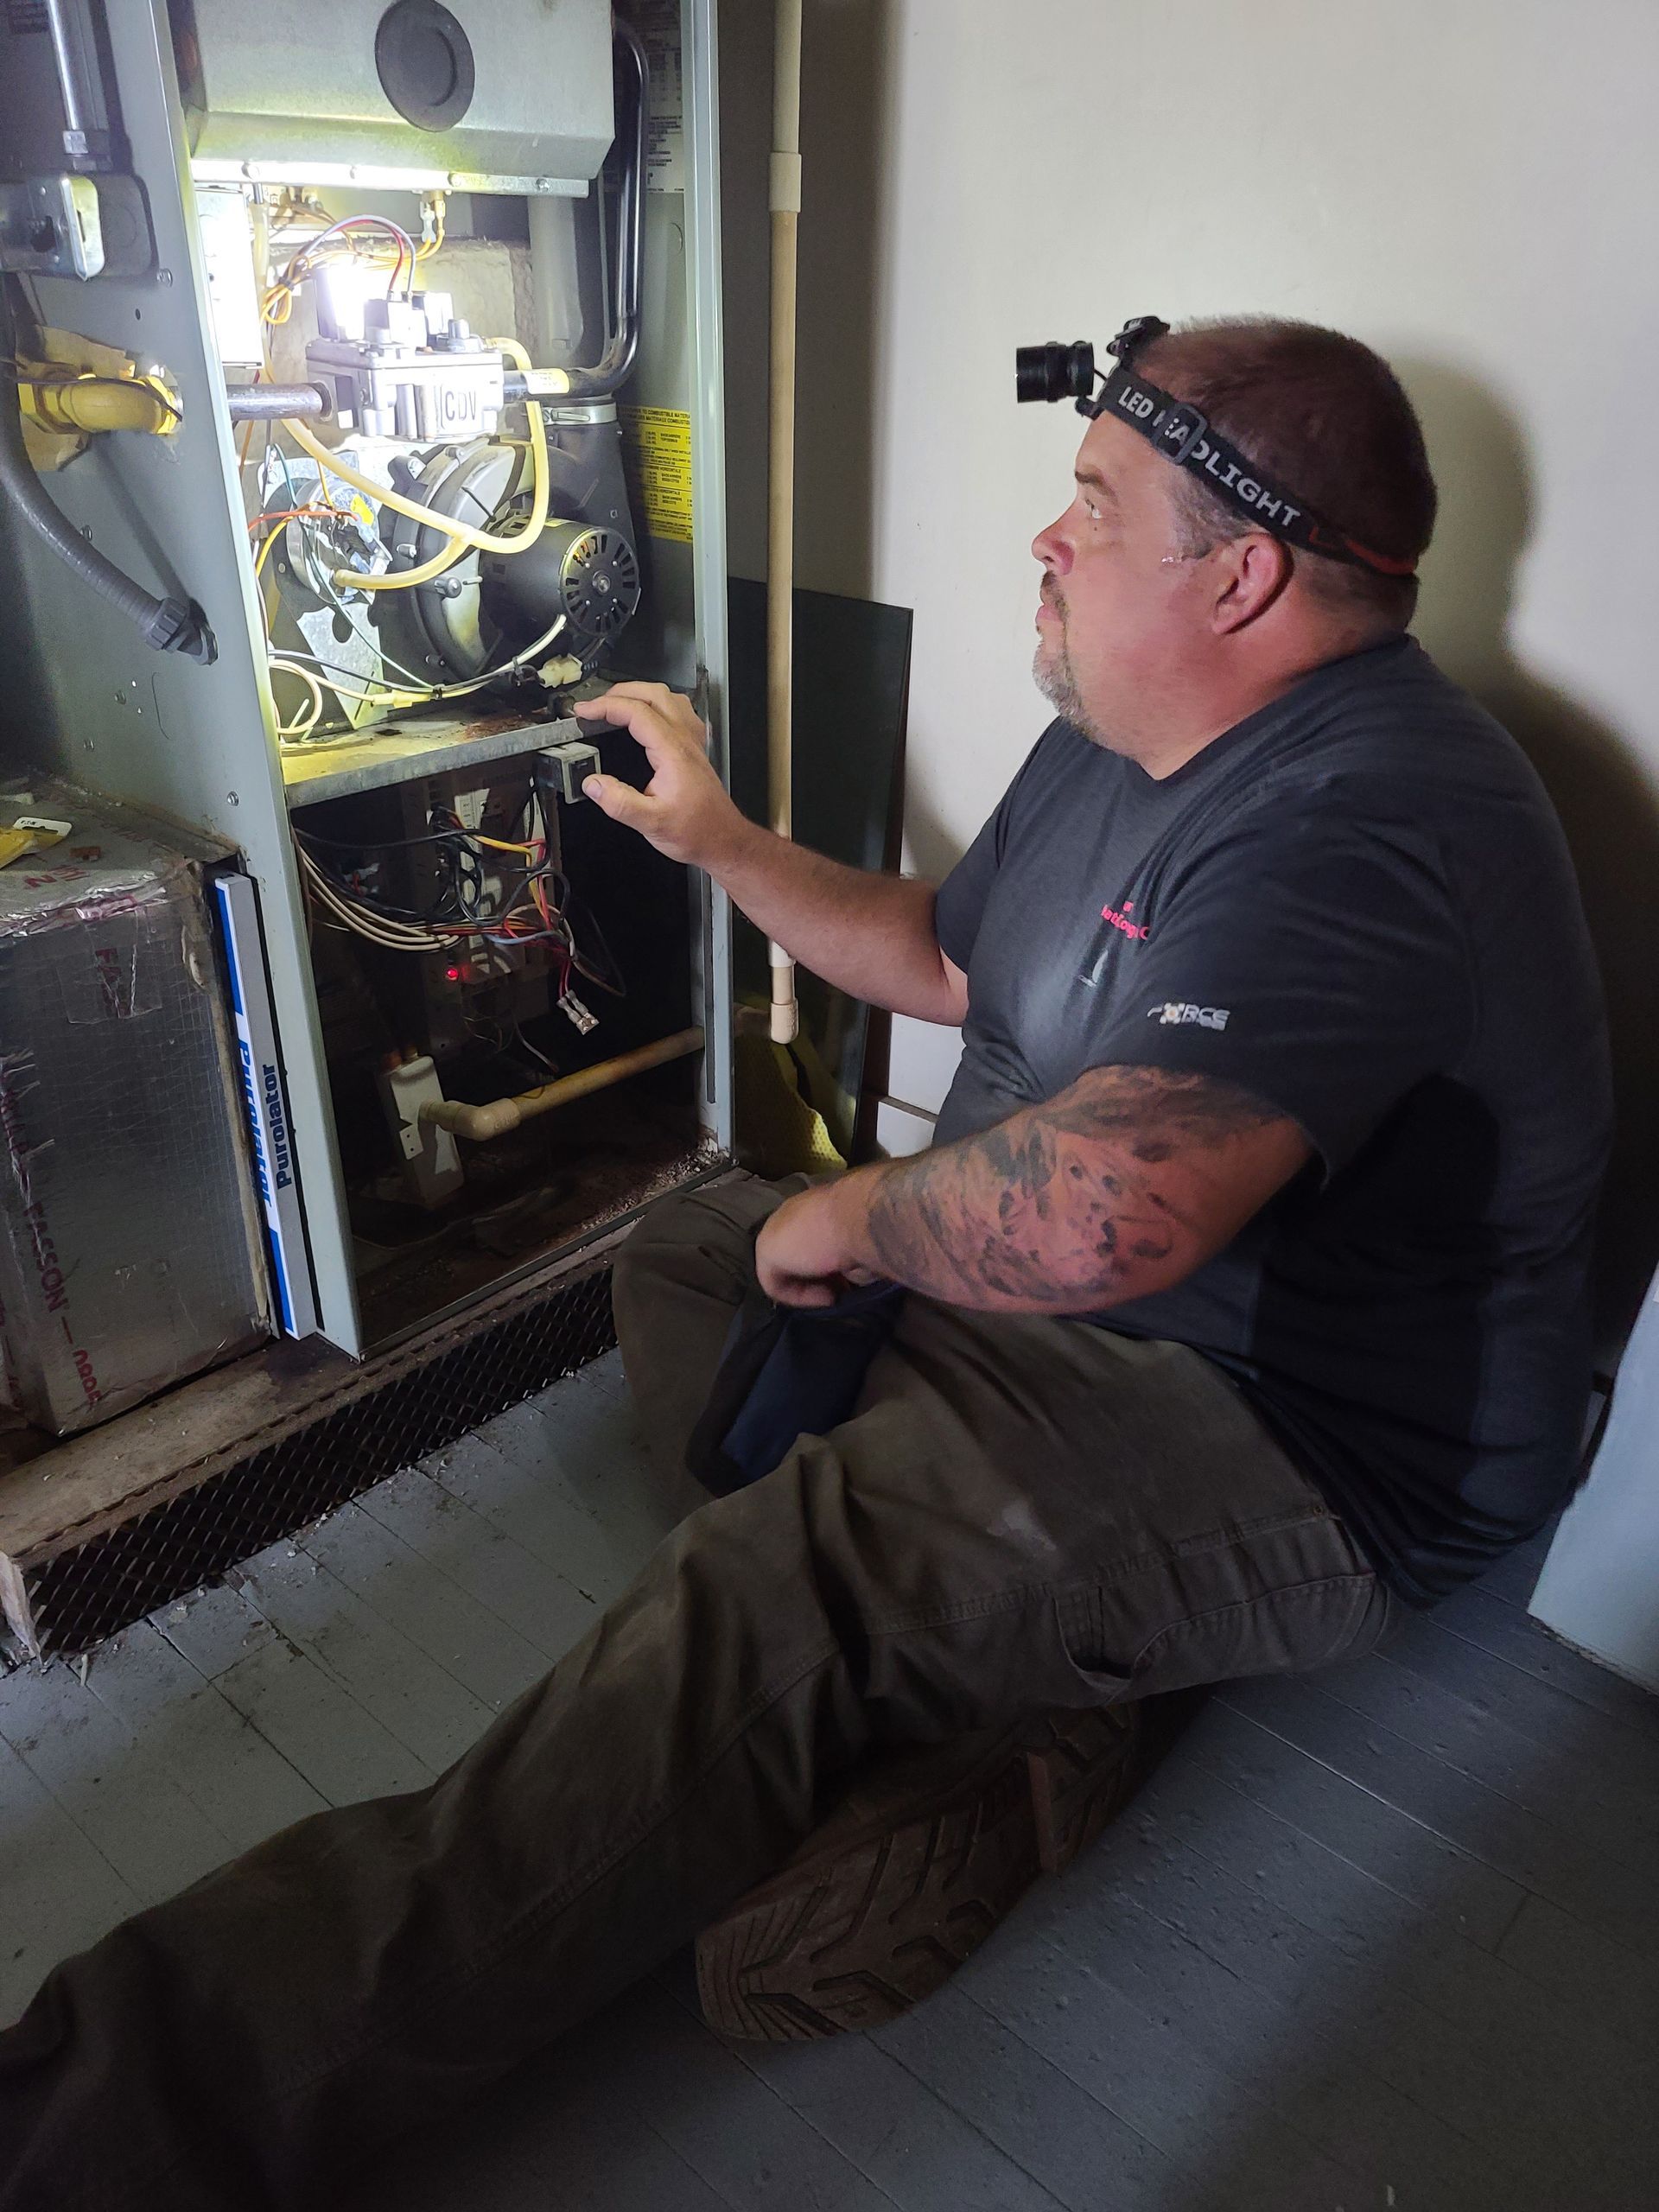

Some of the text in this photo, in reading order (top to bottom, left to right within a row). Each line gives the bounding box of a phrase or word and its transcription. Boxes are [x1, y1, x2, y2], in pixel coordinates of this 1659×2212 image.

[1118, 386, 1154, 418] LED
[238, 1038, 272, 1208] Purolator
[263, 1064, 292, 1190] Purolator
